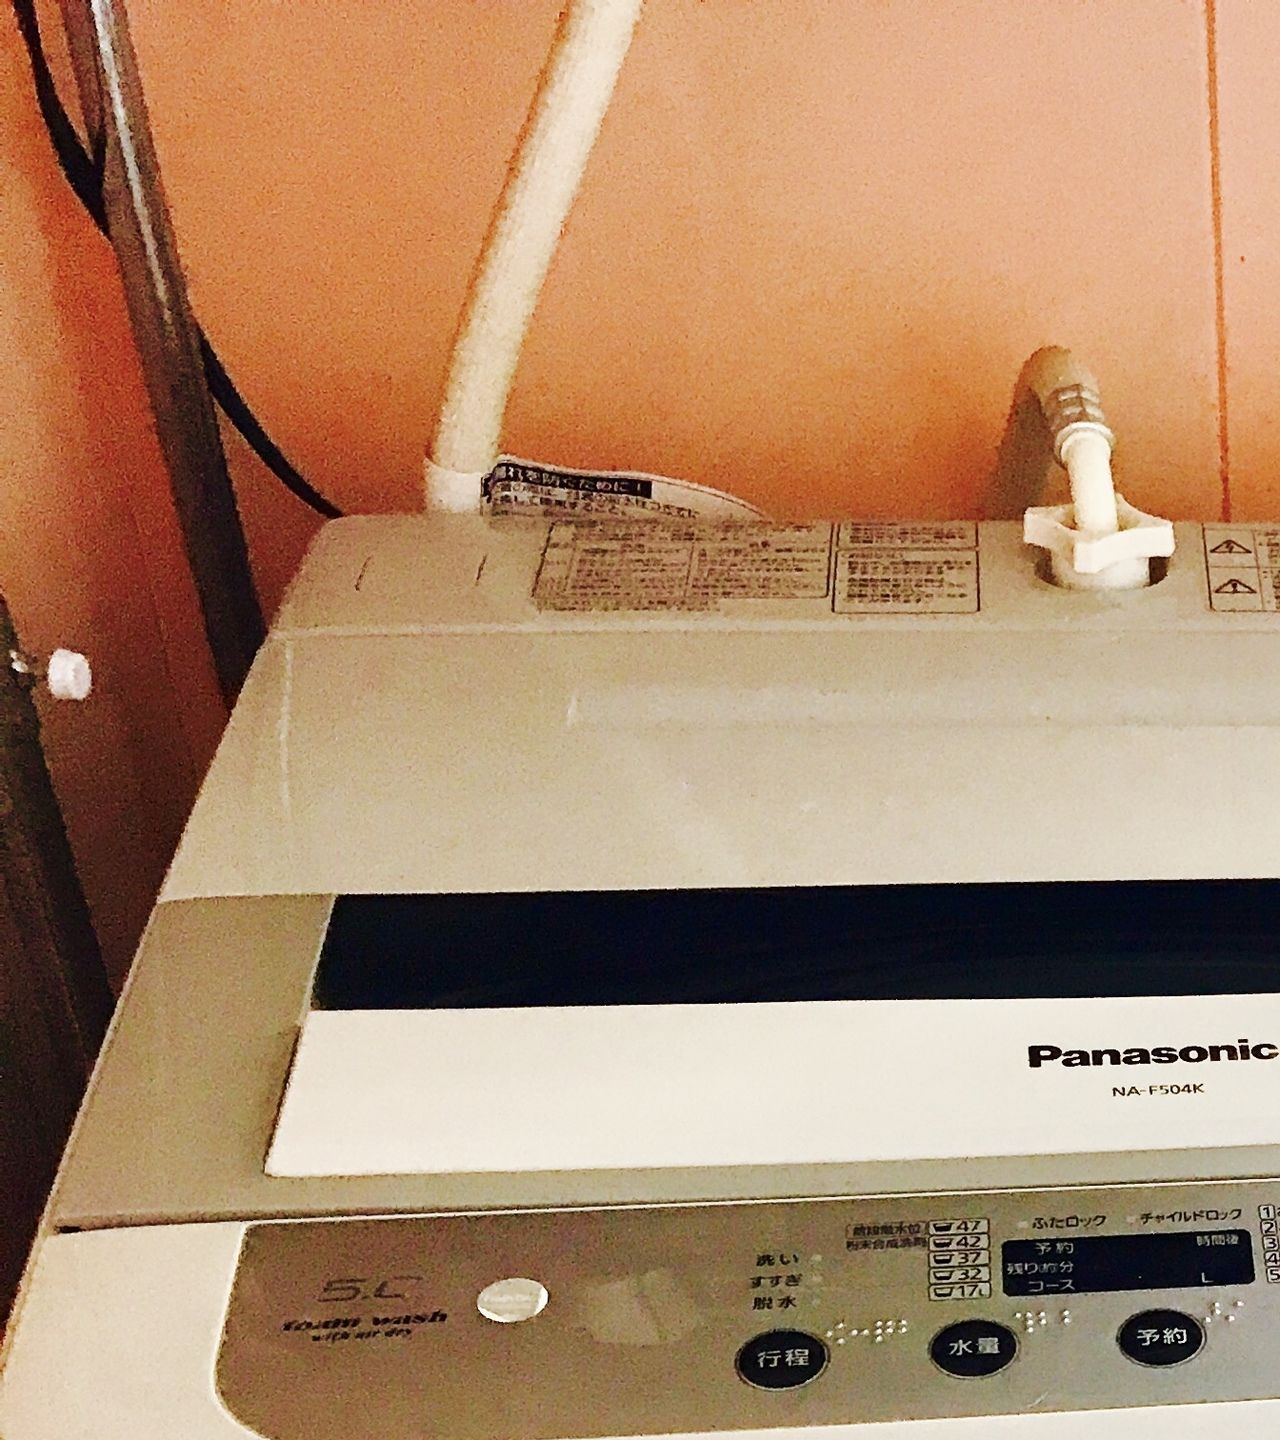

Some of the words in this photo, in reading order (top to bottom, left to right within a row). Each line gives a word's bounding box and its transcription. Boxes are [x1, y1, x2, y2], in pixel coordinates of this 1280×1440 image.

[1027, 1038, 1280, 1068] Panasonic
[1112, 1082, 1206, 1098] NA-F504K
[1031, 1214, 1107, 1230] ふたロック
[1139, 1208, 1242, 1224] チャイルドロック
[956, 1220, 981, 1232] 47
[956, 1236, 982, 1248] 42
[1034, 1241, 1075, 1256] 予約
[755, 1253, 799, 1267] 洗い
[957, 1252, 981, 1265] 37
[749, 1272, 803, 1289] すすぎ
[957, 1268, 983, 1281] 32
[1028, 1279, 1077, 1293] コース
[752, 1296, 798, 1311] 脱水
[1136, 1327, 1188, 1346] 予約
[948, 1336, 1001, 1357] 水量
[756, 1348, 810, 1368] 行程
